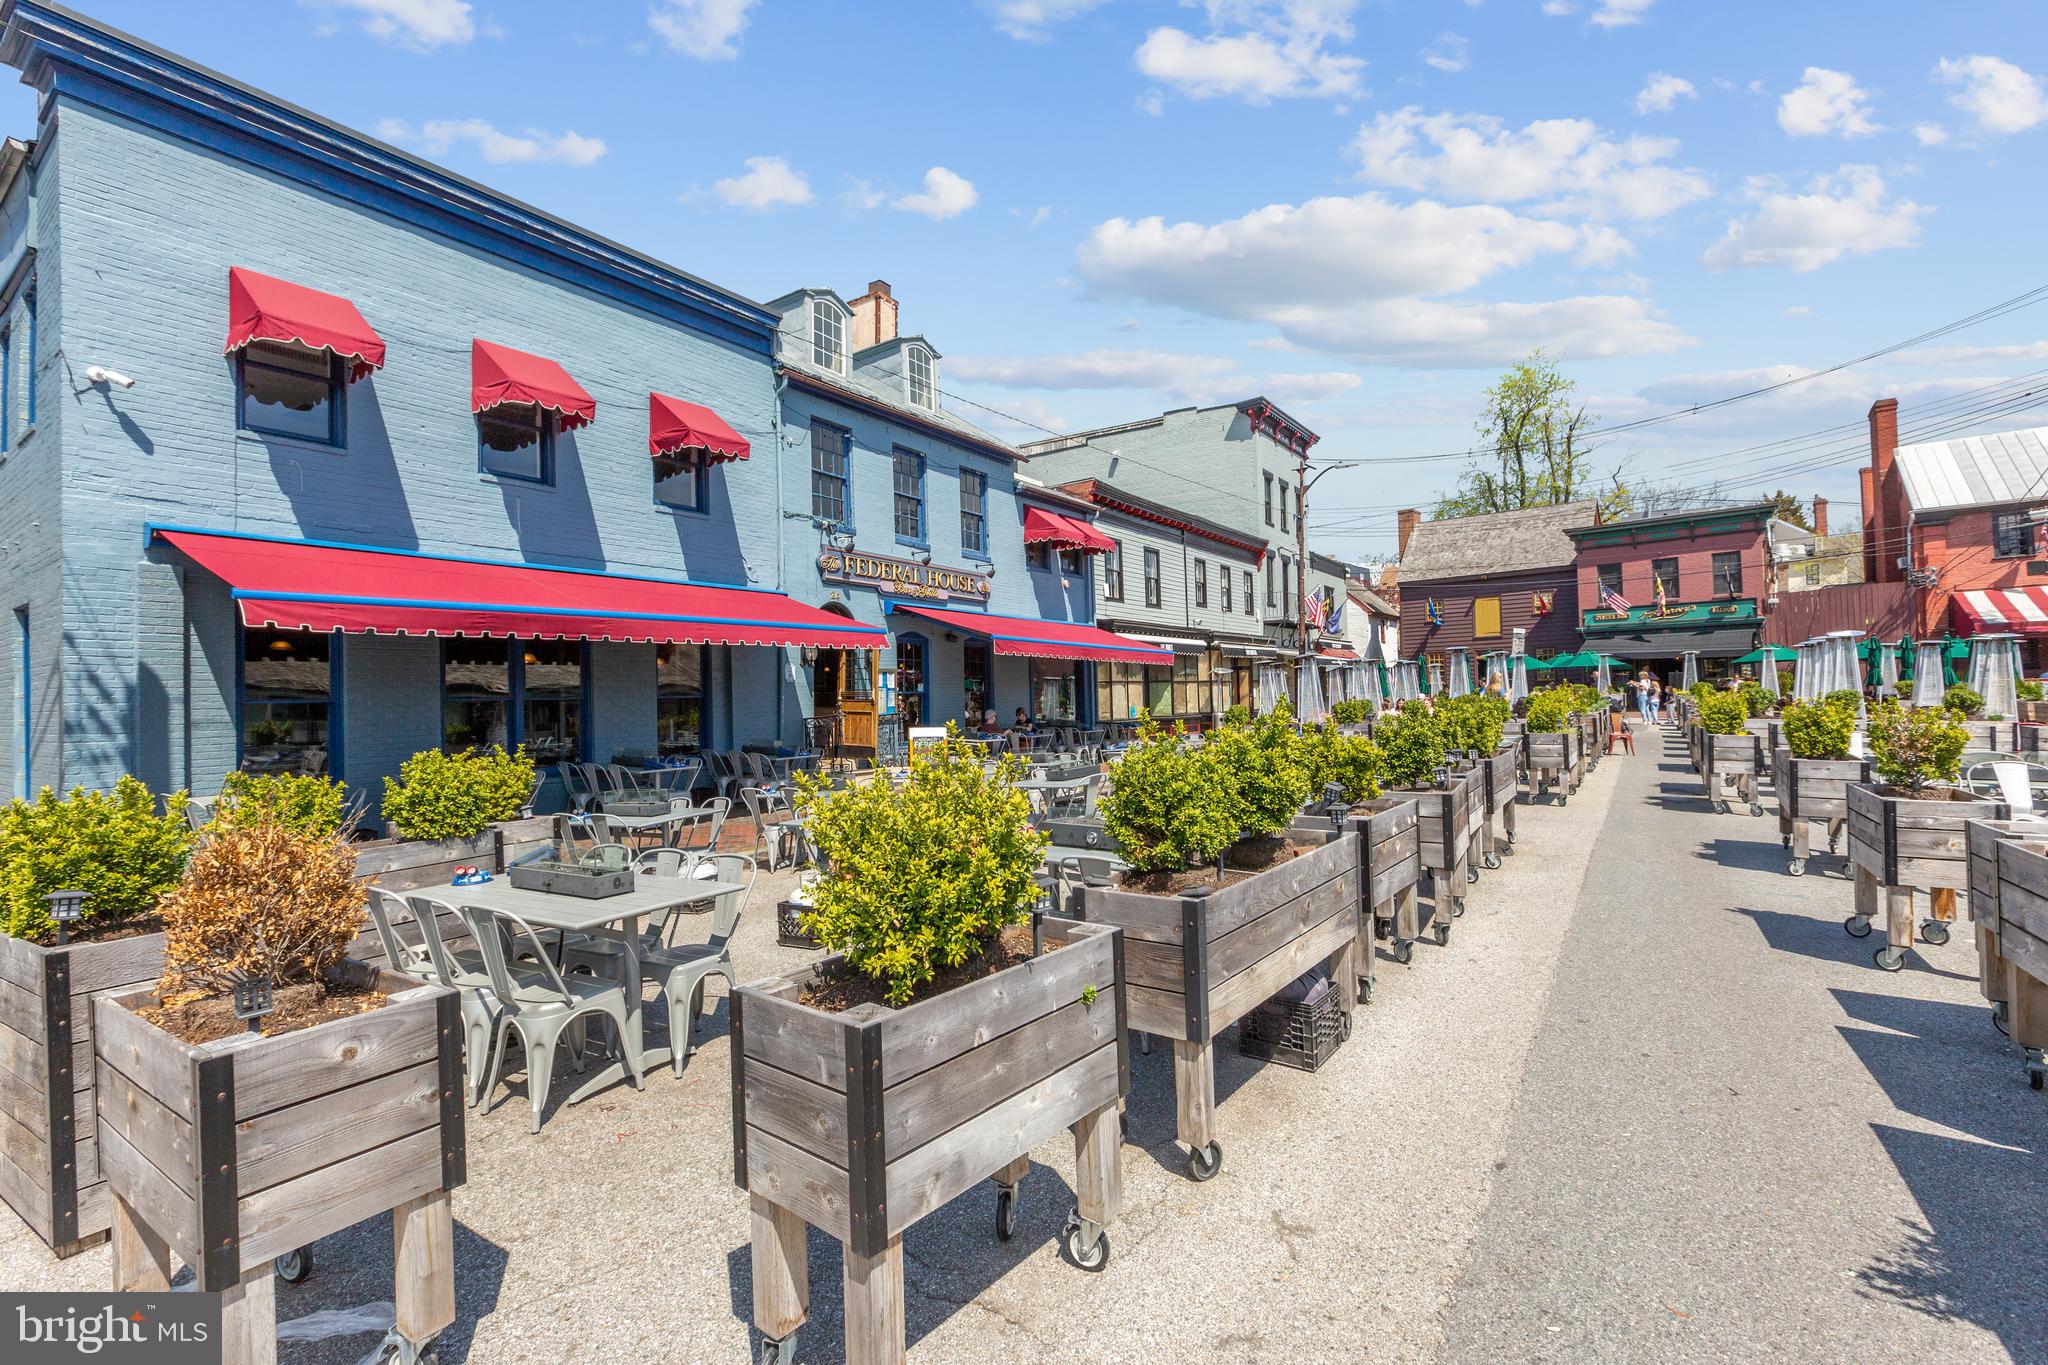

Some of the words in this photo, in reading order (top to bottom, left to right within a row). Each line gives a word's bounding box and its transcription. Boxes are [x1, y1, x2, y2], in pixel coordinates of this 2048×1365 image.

[820, 556, 839, 571] The
[844, 555, 922, 585] FEDERAL
[927, 570, 976, 593] HOUSE
[894, 580, 912, 594] Bar
